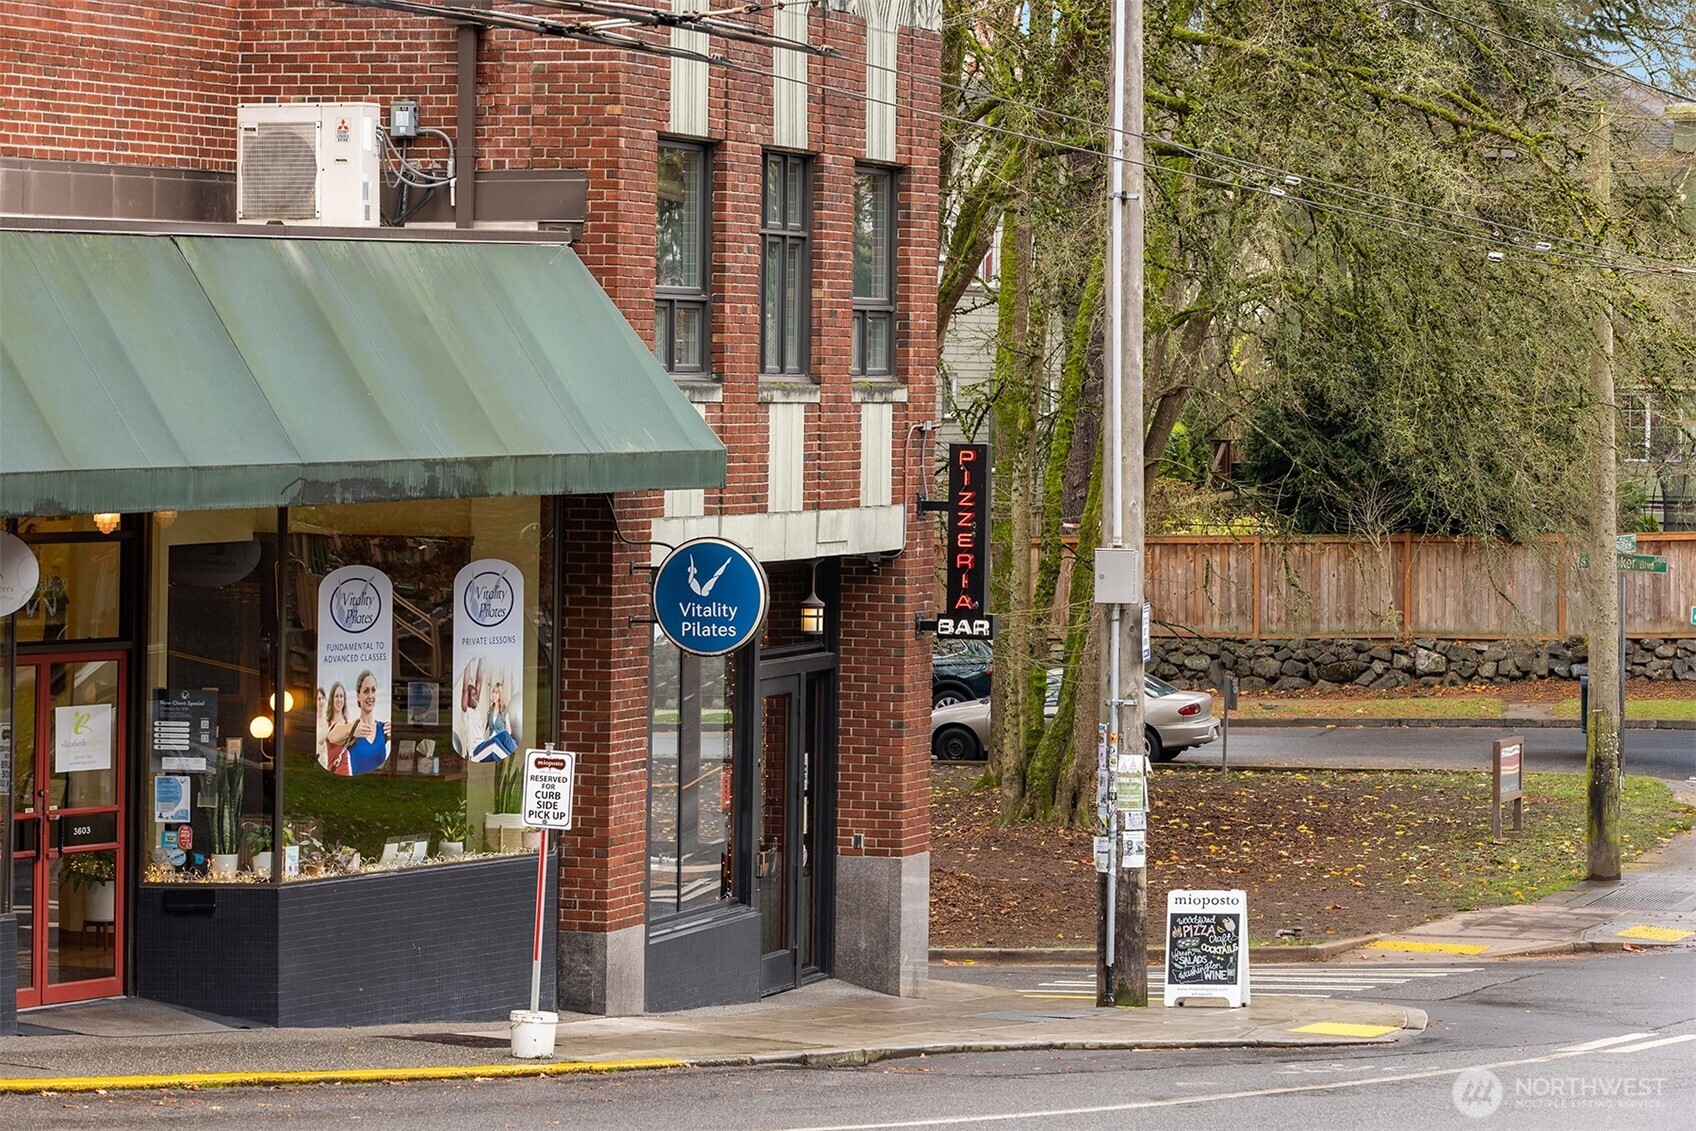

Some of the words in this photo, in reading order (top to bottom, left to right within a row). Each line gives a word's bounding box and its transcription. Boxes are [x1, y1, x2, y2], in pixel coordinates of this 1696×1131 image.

[955, 450, 977, 610] PIZZERIA
[1640, 560, 1655, 570] Blvd
[476, 585, 507, 604] Vitality
[343, 591, 375, 610] Vitality
[478, 602, 506, 618] Pilates
[679, 601, 738, 621] Vitality
[345, 609, 374, 625] Pilates
[681, 621, 737, 637] Pilates
[937, 618, 990, 636] BAR
[461, 637, 487, 646] PRIVATE
[489, 635, 516, 645] LESSONS
[326, 642, 374, 652] FUNDAMENTAL
[376, 641, 385, 650] TO
[323, 654, 359, 663] ADVANCED
[360, 652, 387, 662] CLASSES
[530, 774, 568, 784] RESERVED
[534, 790, 561, 800] CURB
[536, 800, 559, 810] SIDE
[528, 809, 551, 820] PICK
[552, 811, 566, 820] UP
[73, 826, 91, 836] 3603
[1174, 893, 1240, 909] mioposto
[1182, 924, 1216, 938] PIZZA
[1200, 943, 1239, 955] COCKTAILS
[1179, 955, 1208, 965] SALADS
[1203, 970, 1228, 980] WINE
